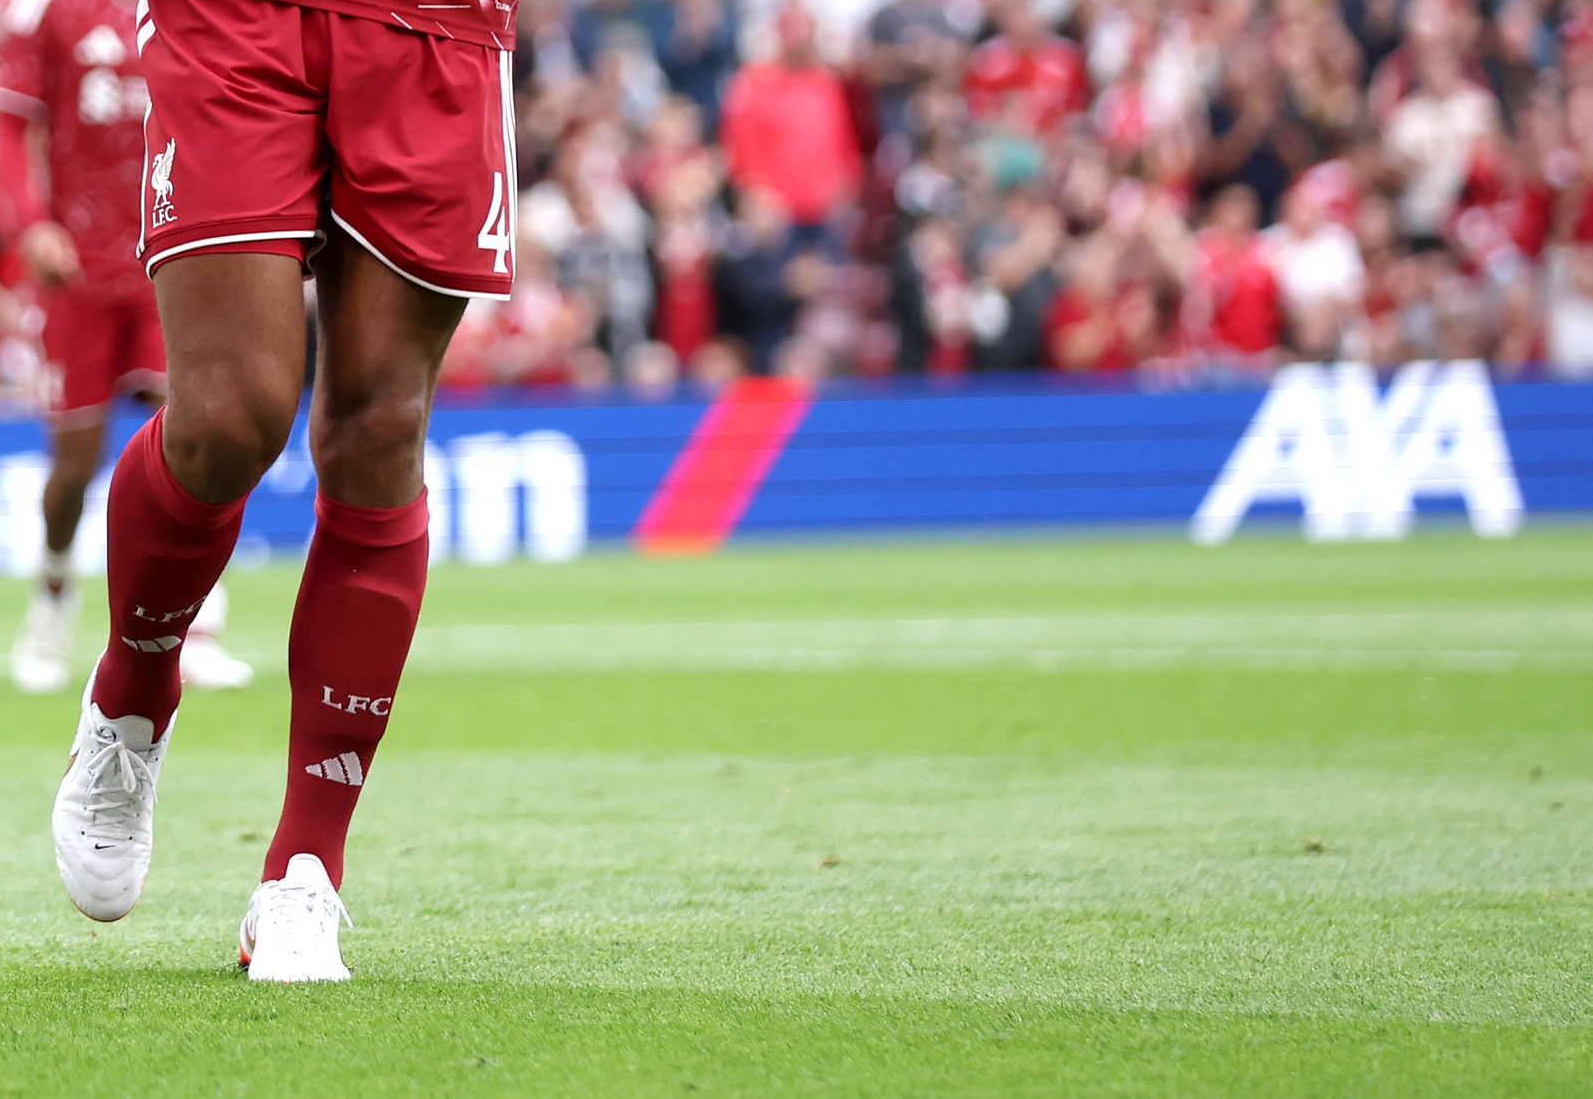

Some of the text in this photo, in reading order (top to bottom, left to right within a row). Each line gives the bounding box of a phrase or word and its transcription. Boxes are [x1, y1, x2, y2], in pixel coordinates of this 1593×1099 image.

[151, 204, 178, 229] L.F.C.
[477, 170, 510, 274] 4
[1190, 359, 1526, 546] AXA
[133, 594, 208, 623] LFC
[321, 684, 392, 717] LFC
